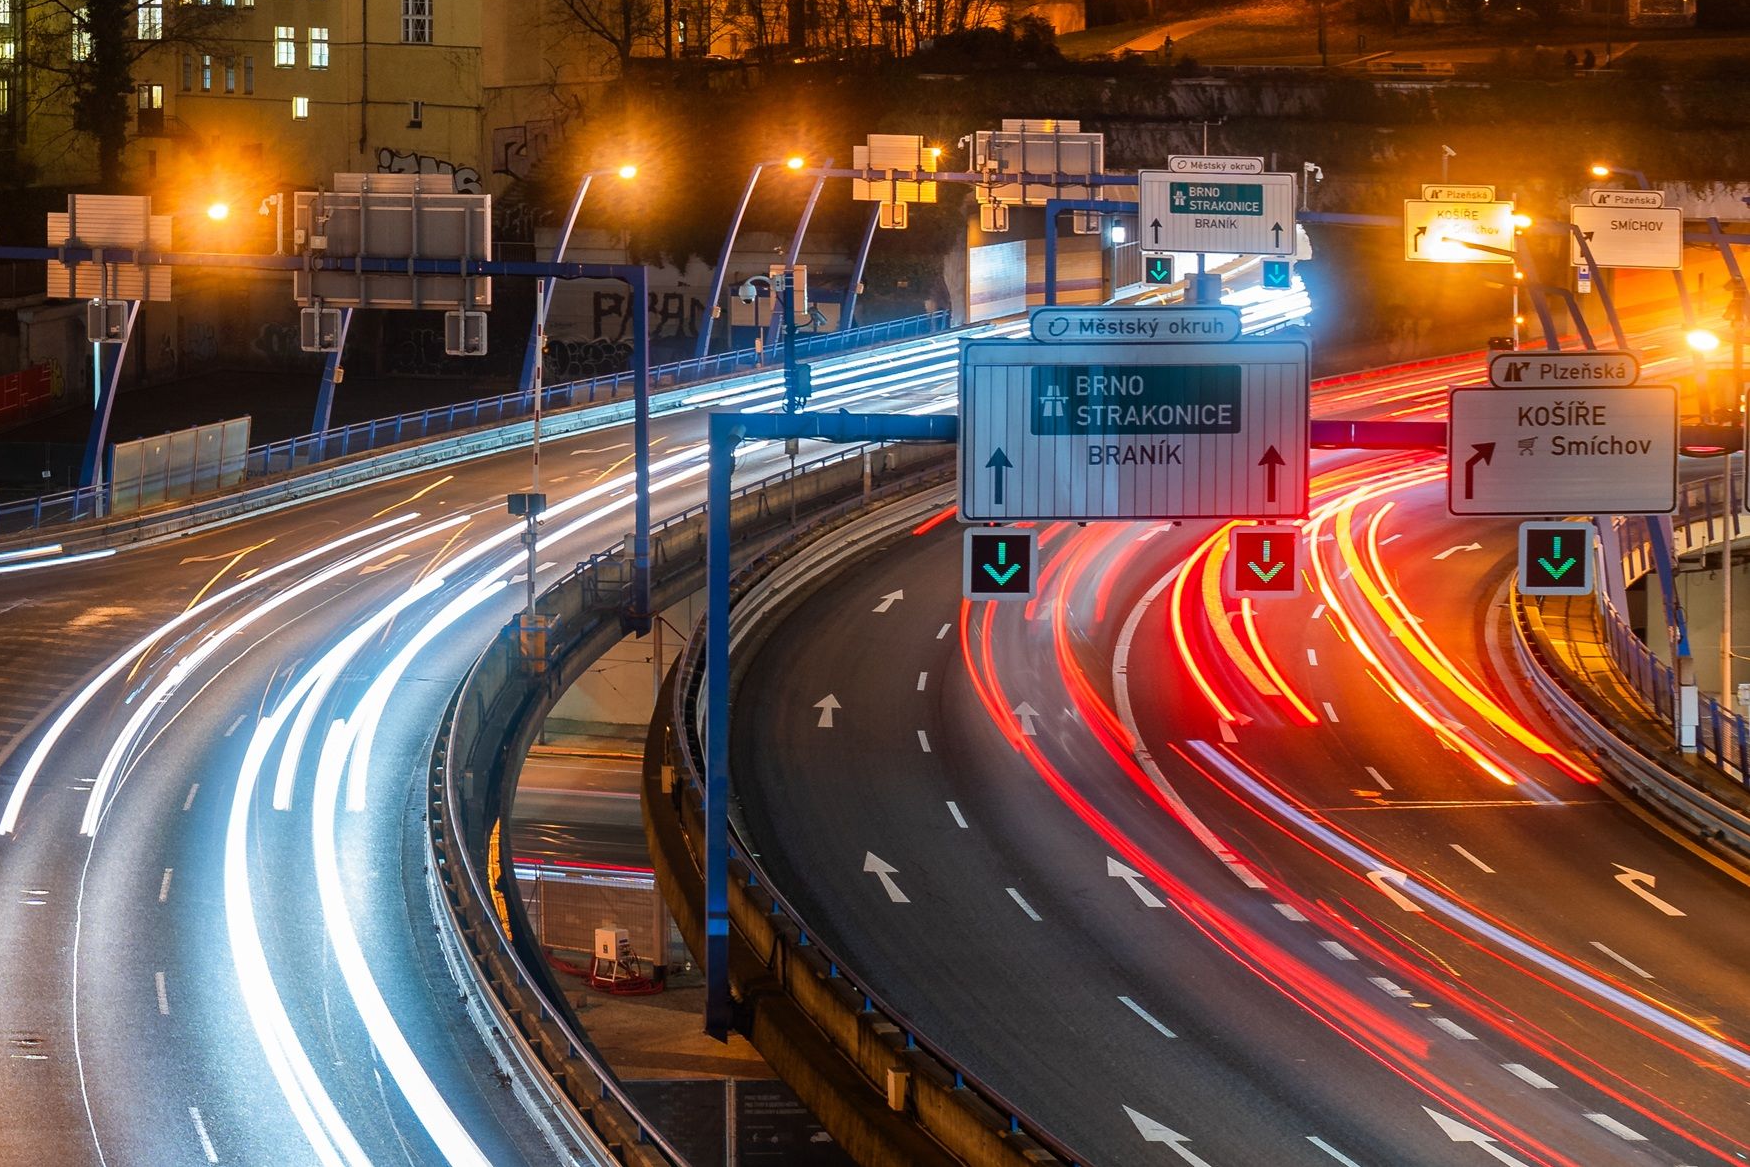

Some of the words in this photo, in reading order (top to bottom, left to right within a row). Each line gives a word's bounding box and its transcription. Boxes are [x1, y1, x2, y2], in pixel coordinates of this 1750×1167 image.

[1190, 160, 1227, 172] Městský
[1230, 162, 1256, 171] okruh
[1189, 186, 1220, 198] BRNO
[1446, 190, 1488, 200] Plzeňská
[1189, 200, 1260, 213] STRAKONICE
[1614, 194, 1657, 205] Plzeňská
[1437, 208, 1480, 221] KOŠÍŘE
[1195, 218, 1238, 230] BRANÍK
[1610, 218, 1664, 232] SMÍCHOV
[1079, 316, 1159, 338] Městský
[1169, 317, 1225, 334] okruh
[1539, 362, 1626, 380] Plzeňská
[1076, 375, 1144, 396] BRNO
[1076, 403, 1232, 426] STRAKONICE
[1518, 400, 1607, 427] KOŠÍŘE
[1550, 435, 1652, 456] Smíchov
[1088, 440, 1182, 466] BRANÍK
